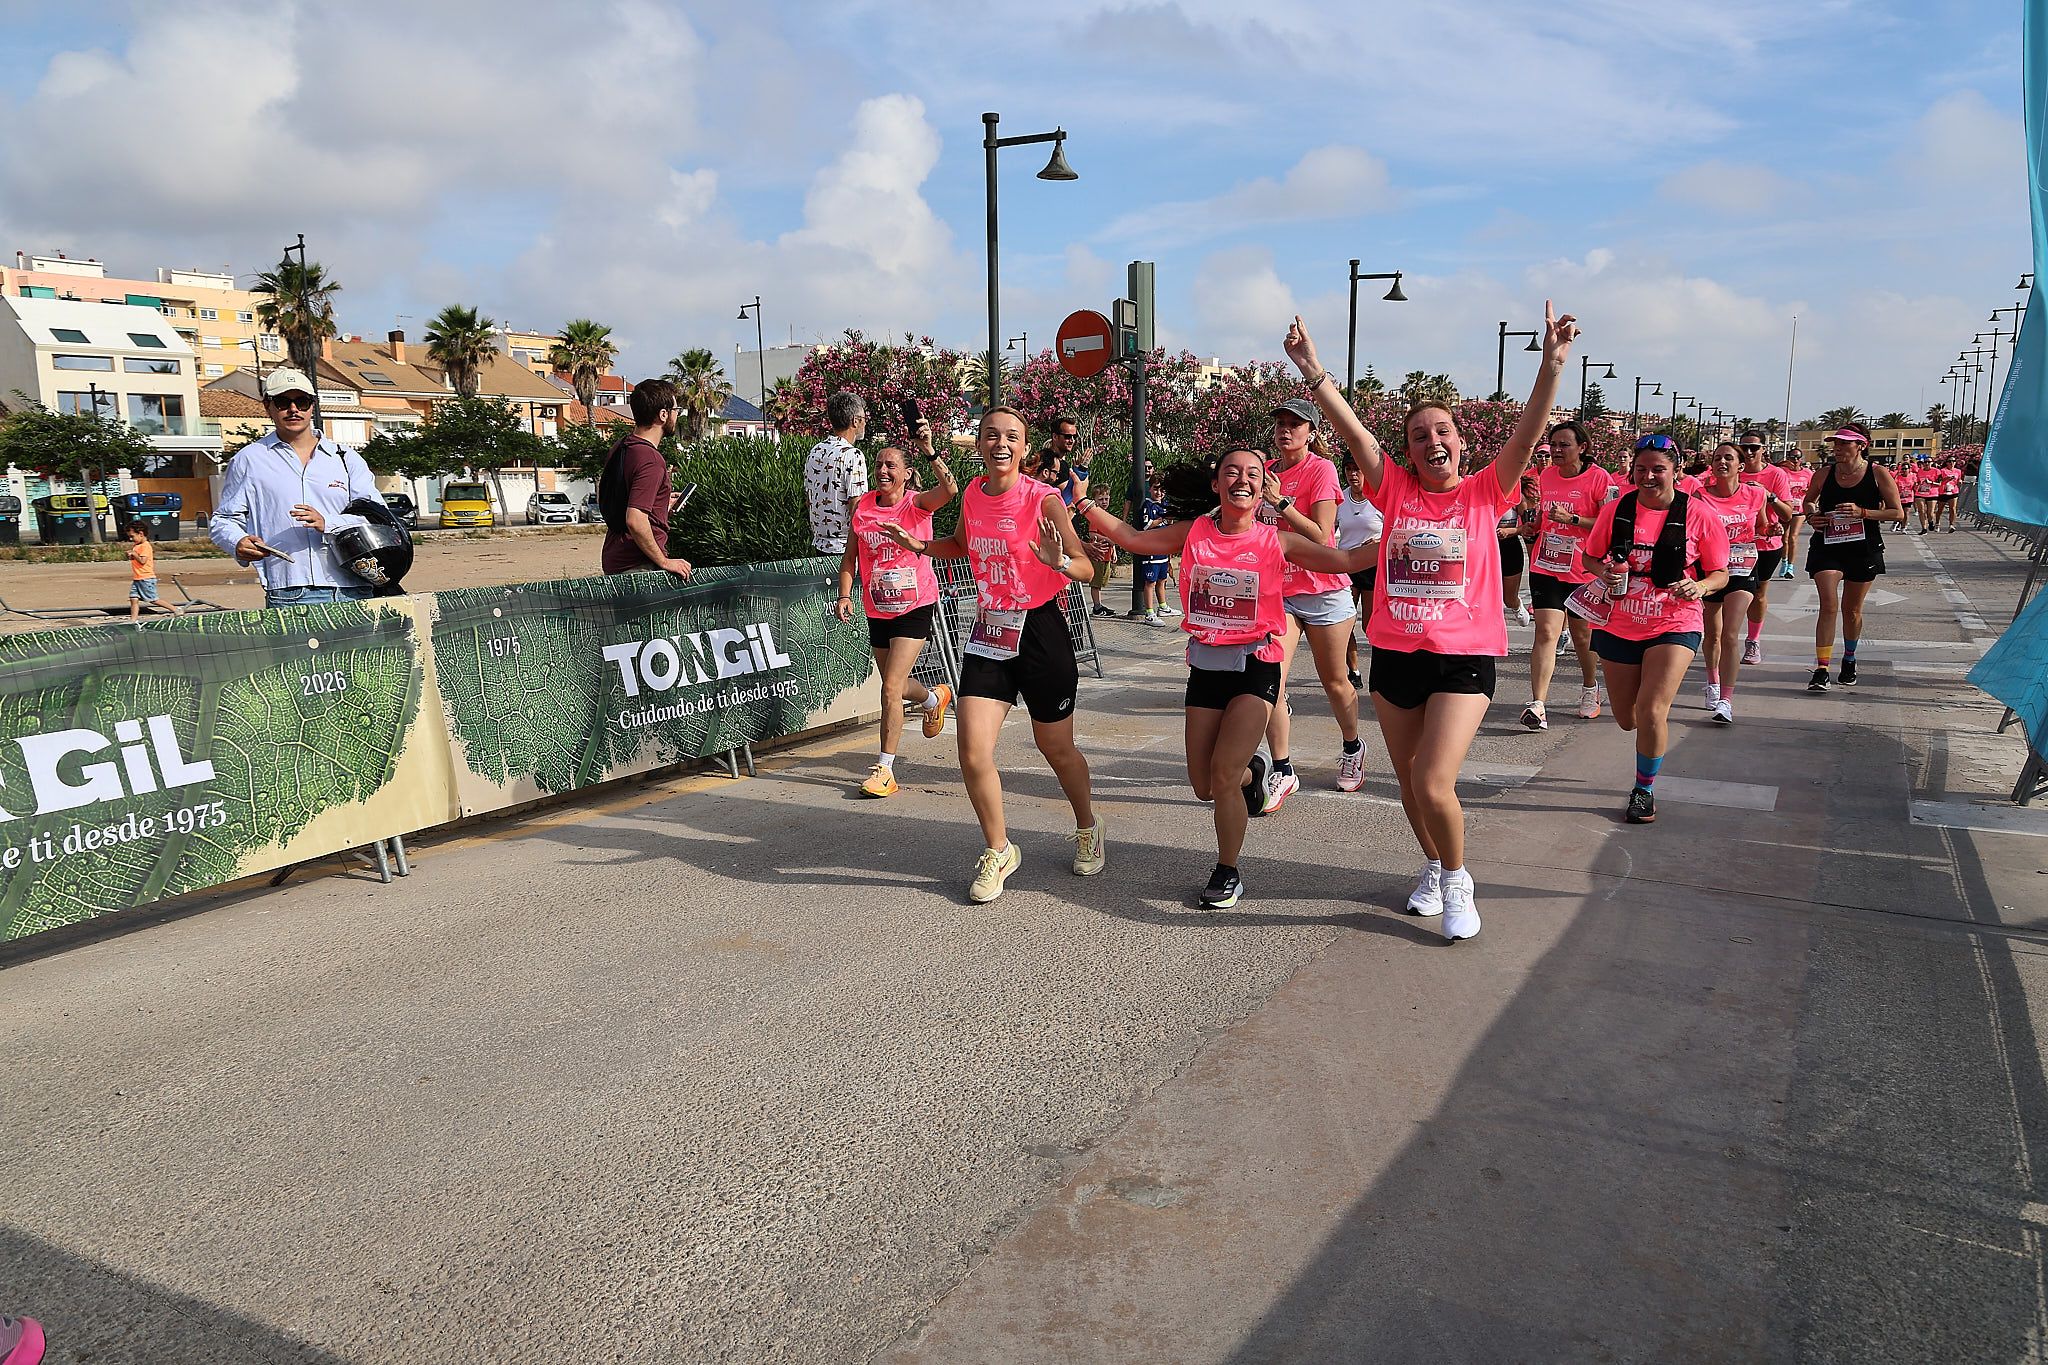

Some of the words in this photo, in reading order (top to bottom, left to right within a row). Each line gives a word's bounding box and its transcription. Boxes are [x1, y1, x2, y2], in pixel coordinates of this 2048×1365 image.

[1264, 517, 1277, 525] 016
[882, 547, 894, 561] DE
[990, 562, 1007, 584] DE
[1411, 560, 1440, 572] 016
[885, 589, 902, 598] 016
[1583, 590, 1601, 605] 016
[1210, 595, 1235, 608] 016
[1620, 600, 1664, 616] MUJER
[1390, 601, 1444, 620] MUJER
[1631, 615, 1648, 625] 2026
[986, 624, 1003, 637] 016
[1405, 622, 1423, 633] 2026
[486, 637, 520, 657] 1975
[301, 671, 346, 695] 2026
[620, 699, 695, 729] Cuidando
[698, 693, 715, 714] de
[717, 689, 732, 708] ti
[733, 682, 769, 705] desde
[771, 679, 799, 700] 1975
[29, 832, 57, 862] ti
[63, 813, 155, 856] desde
[161, 800, 227, 834] 1975
